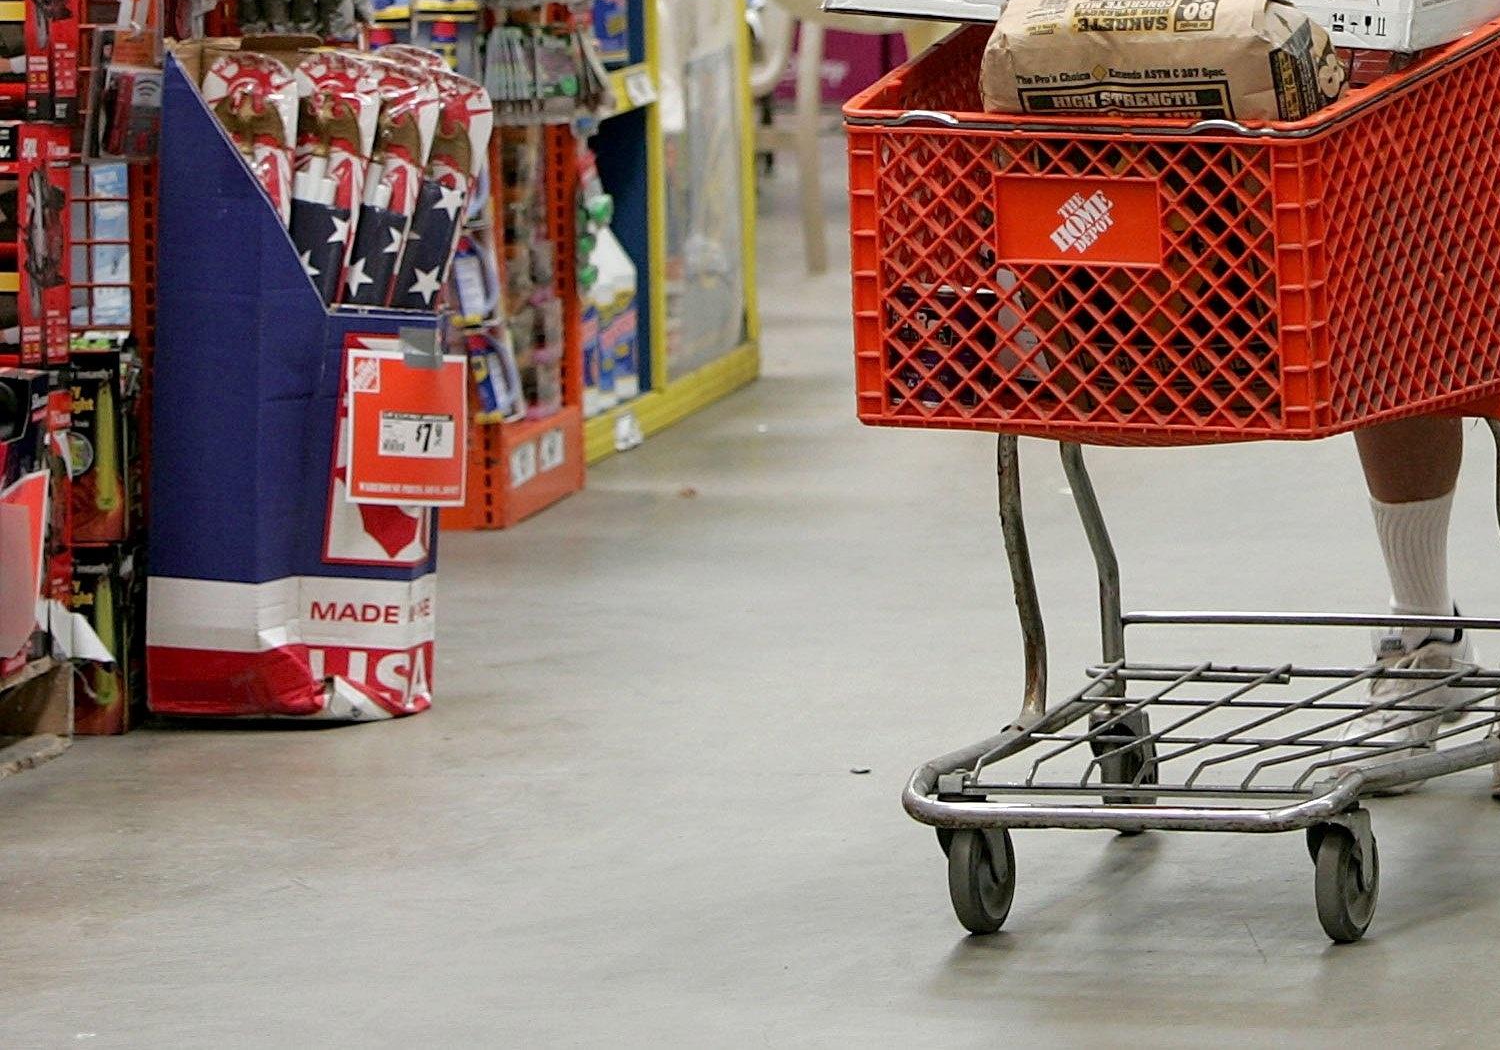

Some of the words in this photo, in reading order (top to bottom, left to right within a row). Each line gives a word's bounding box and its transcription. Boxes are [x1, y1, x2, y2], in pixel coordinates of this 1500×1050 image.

[1103, 0, 1175, 9] CONCRETE
[1183, 1, 1216, 21] 80
[1077, 16, 1168, 32] SAKRETE
[1332, 13, 1345, 23] 14
[1016, 74, 1033, 85] The
[1035, 73, 1057, 84] Pro's
[1060, 71, 1091, 82] Choice
[1144, 68, 1170, 79] ASTM
[1173, 68, 1180, 78] C
[1051, 94, 1097, 108] HIGH
[1100, 91, 1199, 108] STRENGTH
[1057, 192, 1085, 220] THE
[1049, 189, 1114, 252] HOME
[1073, 212, 1114, 254] DEPOT
[310, 601, 401, 624] MADE
